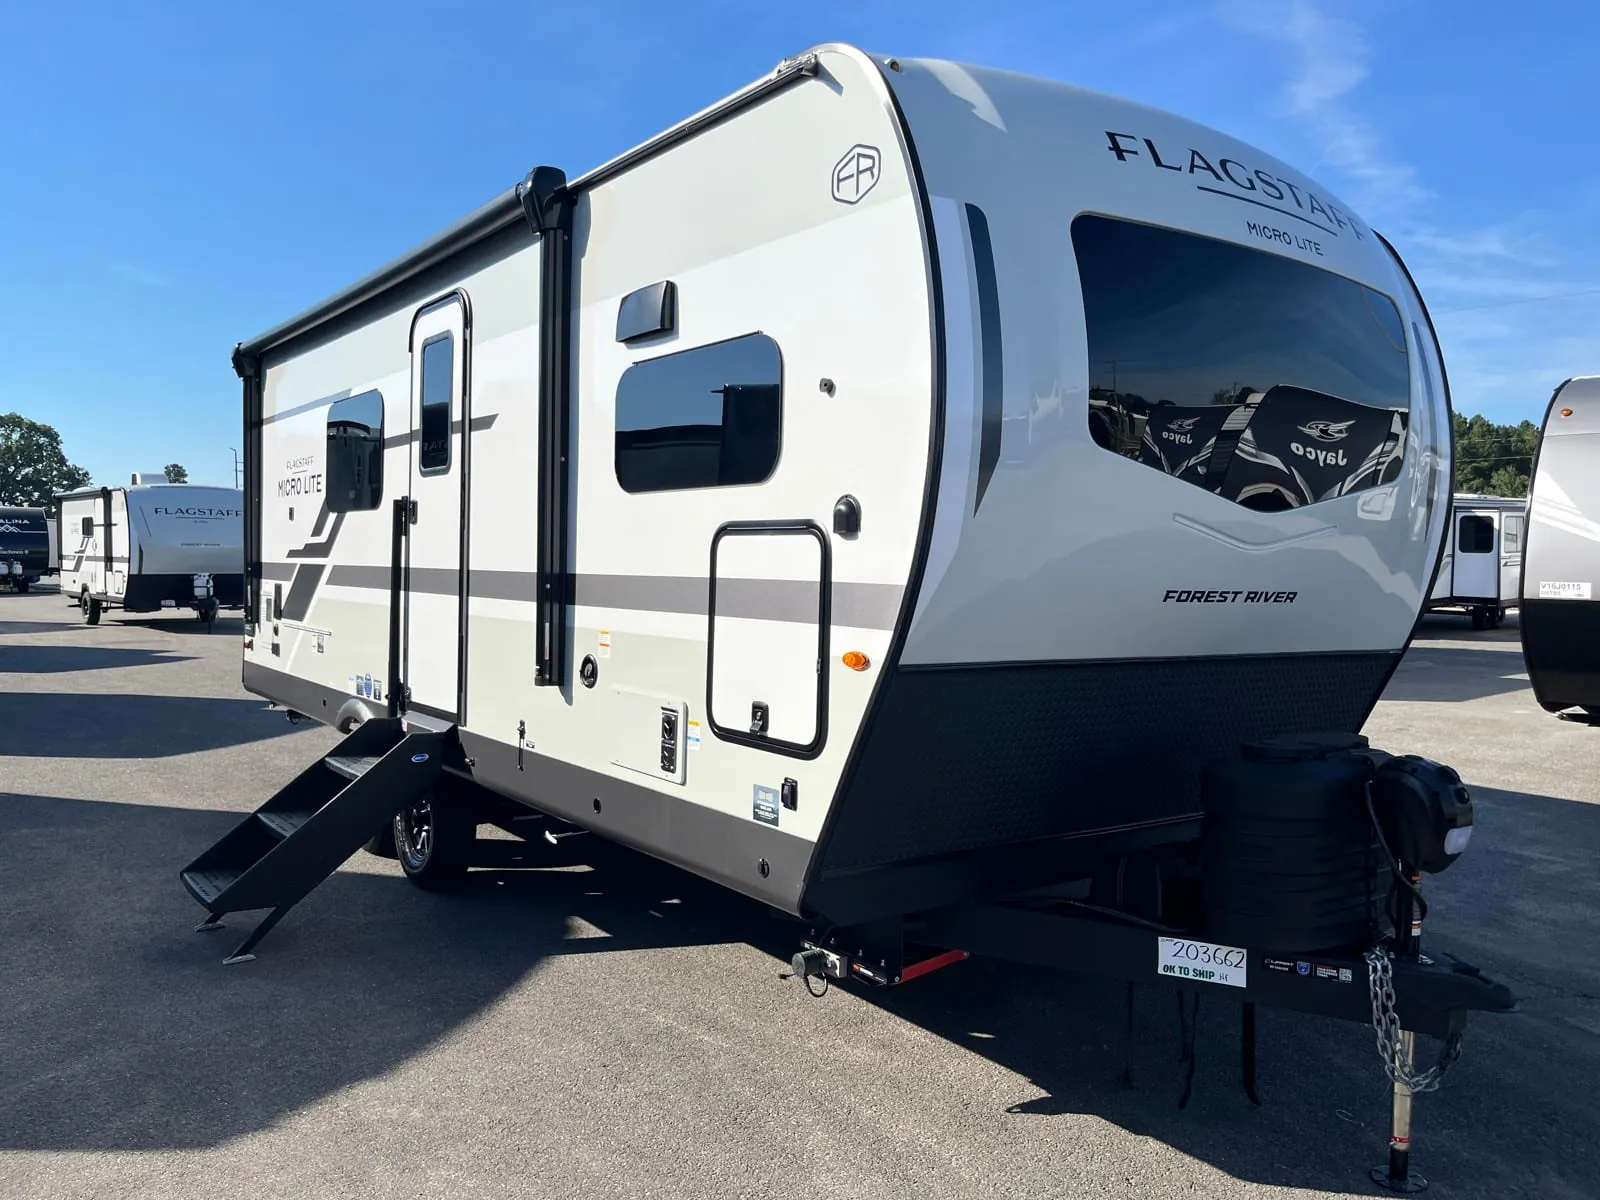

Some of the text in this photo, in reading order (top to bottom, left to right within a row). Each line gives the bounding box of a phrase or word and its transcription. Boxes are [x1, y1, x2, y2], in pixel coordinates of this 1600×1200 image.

[1104, 130, 1365, 241] FLAGSTAFF
[1246, 220, 1324, 257] MICRO LITE
[278, 473, 322, 497] MICRO LITE
[154, 507, 243, 517] FLAGSTAFF
[1162, 589, 1298, 604] FOREST RIVER
[1172, 941, 1245, 969] 203662
[1162, 964, 1215, 980] OK TO SHIP
